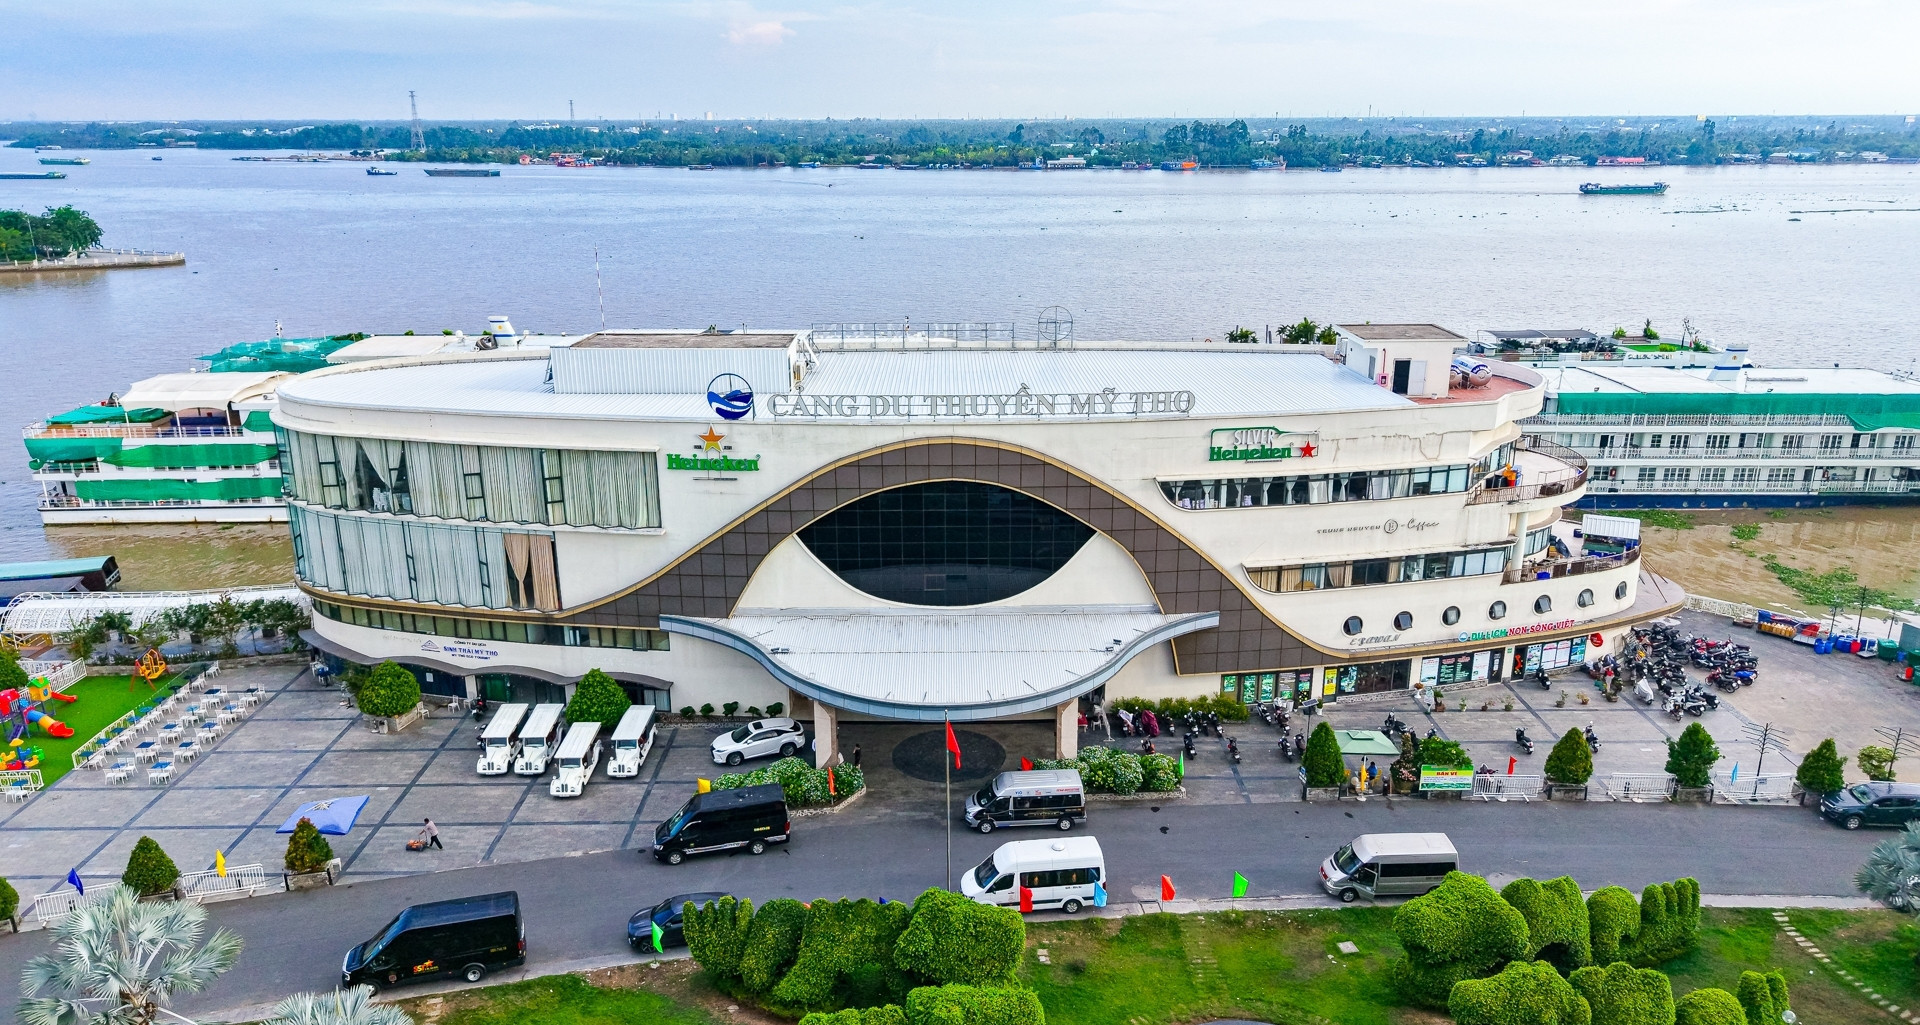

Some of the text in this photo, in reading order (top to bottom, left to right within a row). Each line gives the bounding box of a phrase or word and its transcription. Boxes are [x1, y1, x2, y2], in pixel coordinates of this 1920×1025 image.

[767, 382, 859, 417] CẢNG
[869, 394, 914, 417] DU
[923, 383, 1056, 416] THUYỀN
[1069, 387, 1121, 415] MỸ
[1233, 428, 1275, 445] SILVER
[1209, 444, 1291, 461] Heineken
[666, 453, 760, 471] Heineken
[1471, 631, 1484, 640] DU
[1508, 626, 1528, 636] NON
